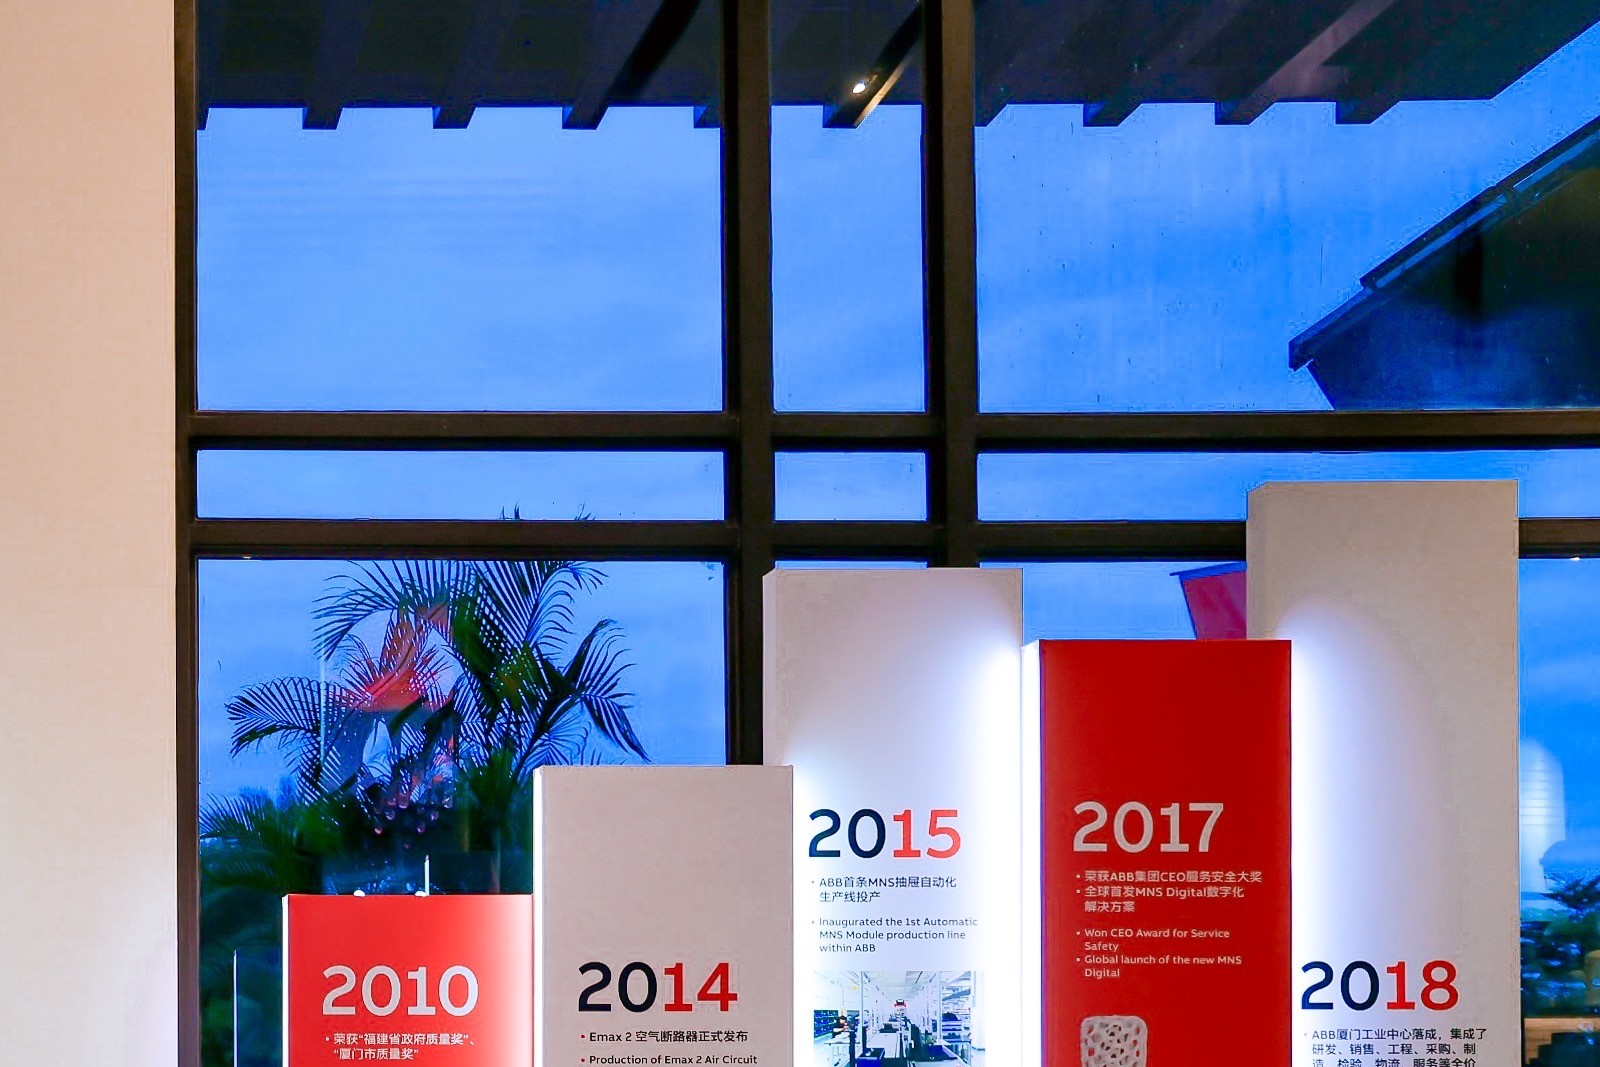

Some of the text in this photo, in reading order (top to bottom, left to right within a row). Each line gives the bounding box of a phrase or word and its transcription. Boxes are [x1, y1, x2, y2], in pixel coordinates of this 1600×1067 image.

[1073, 801, 1225, 853] 2017
[809, 809, 960, 858] 2015
[820, 918, 882, 928] Inaugurated
[886, 918, 902, 926] the
[906, 918, 920, 926] 1st
[847, 931, 883, 939] Module
[887, 931, 944, 941] production
[948, 931, 965, 939] line
[1085, 929, 1229, 937] Won CEO Award for Service
[820, 944, 875, 952] within ABB
[1085, 942, 1118, 952] Safety
[1085, 968, 1119, 979] Digital
[322, 964, 479, 1017] 2010
[579, 962, 737, 1012] 2014
[1301, 961, 1458, 1011] 2018
[590, 1033, 622, 1041] Emax
[626, 1032, 631, 1041] 2
[590, 1055, 647, 1064] Production
[651, 1055, 661, 1064] of
[665, 1056, 693, 1064] Emax
[705, 1055, 719, 1063] Air
[723, 1055, 757, 1064] Circuit
